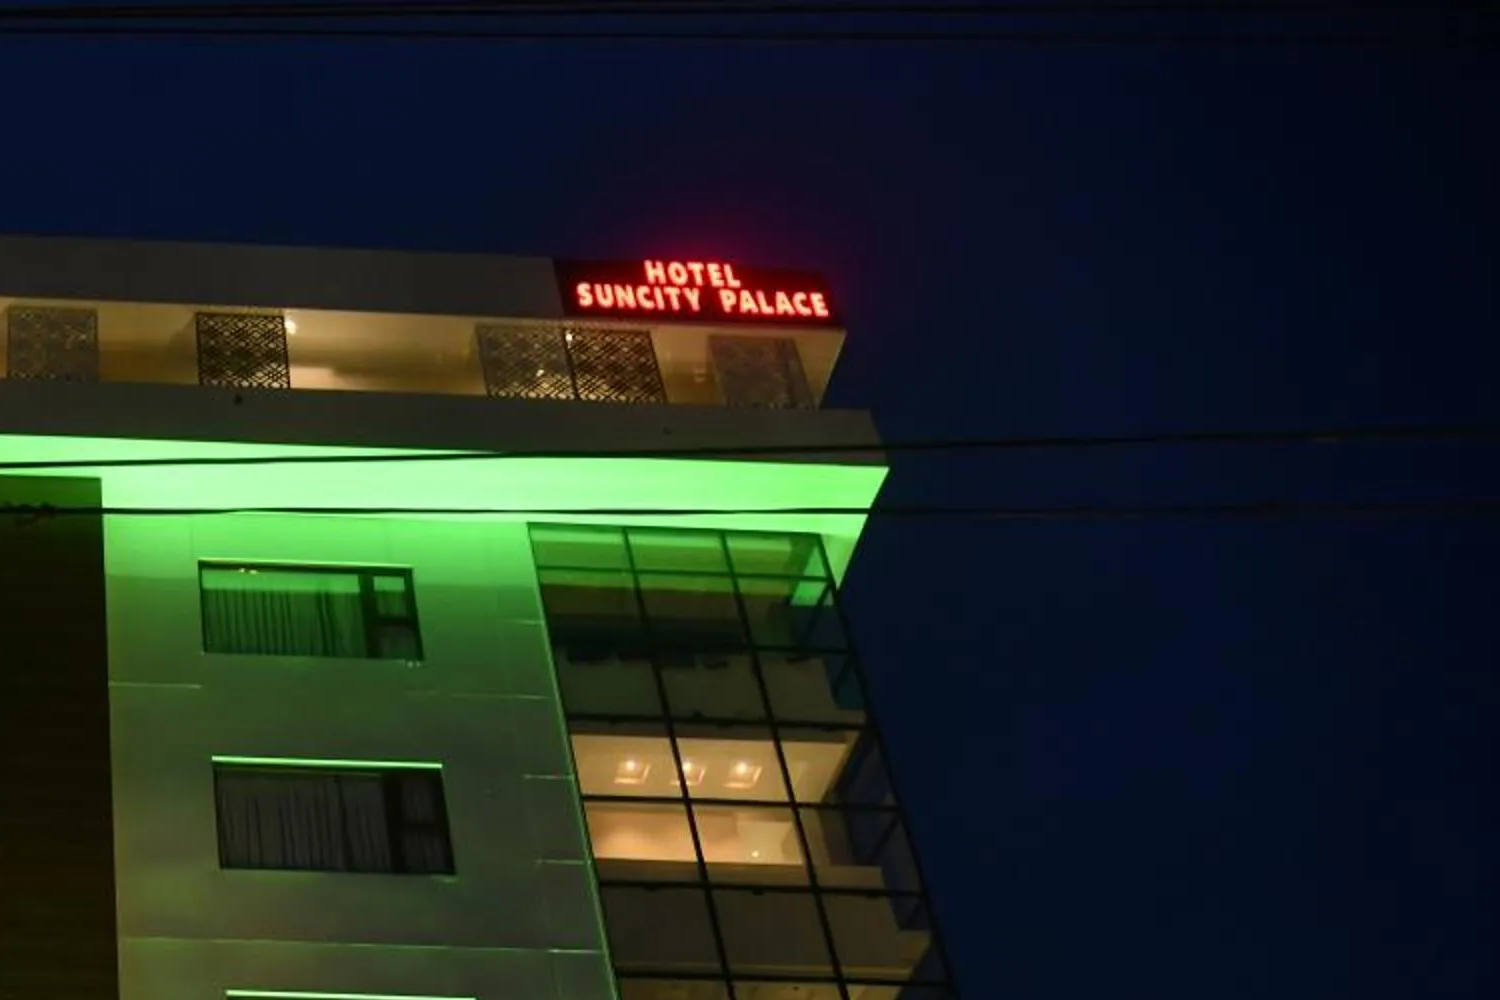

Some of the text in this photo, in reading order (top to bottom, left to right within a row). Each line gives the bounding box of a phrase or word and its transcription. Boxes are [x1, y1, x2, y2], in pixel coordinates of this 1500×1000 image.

[644, 260, 741, 288] HOTEL
[576, 283, 829, 317] SUNCITY PALACE
